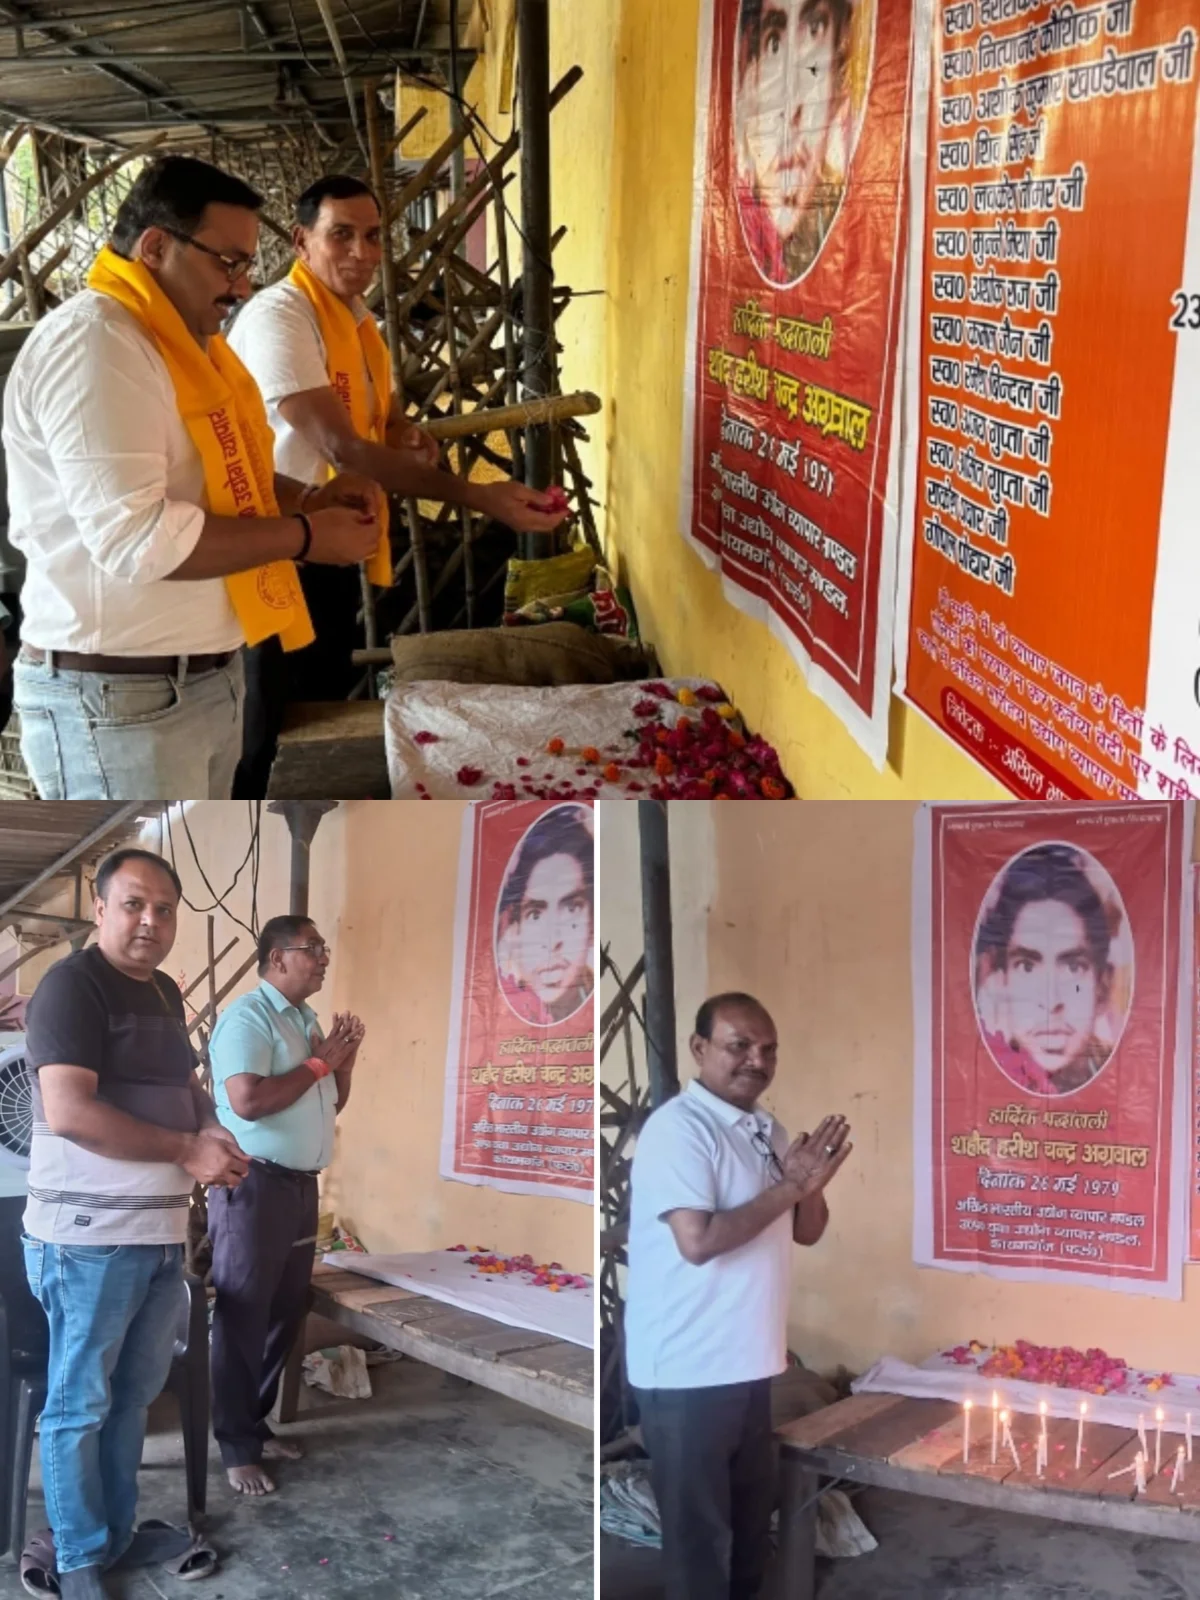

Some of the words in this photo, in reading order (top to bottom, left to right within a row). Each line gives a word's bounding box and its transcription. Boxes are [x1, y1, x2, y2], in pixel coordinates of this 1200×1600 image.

[1164, 30, 1194, 79] जी
[1060, 166, 1084, 208] जी
[1035, 220, 1057, 260] जी
[1035, 272, 1058, 312] जी
[1171, 291, 1200, 329] 23
[1028, 322, 1051, 363] जी
[1037, 375, 1061, 417] जी
[1027, 424, 1051, 465] जी
[1027, 474, 1050, 515] जी
[986, 507, 1008, 545] जी
[993, 555, 1015, 596] जी
[1149, 723, 1168, 752] के
[1127, 749, 1151, 783] पर
[1082, 1144, 1150, 1168] अग्रवाल
[1052, 1174, 1080, 1194] मई
[1083, 1180, 1120, 1196] 1979
